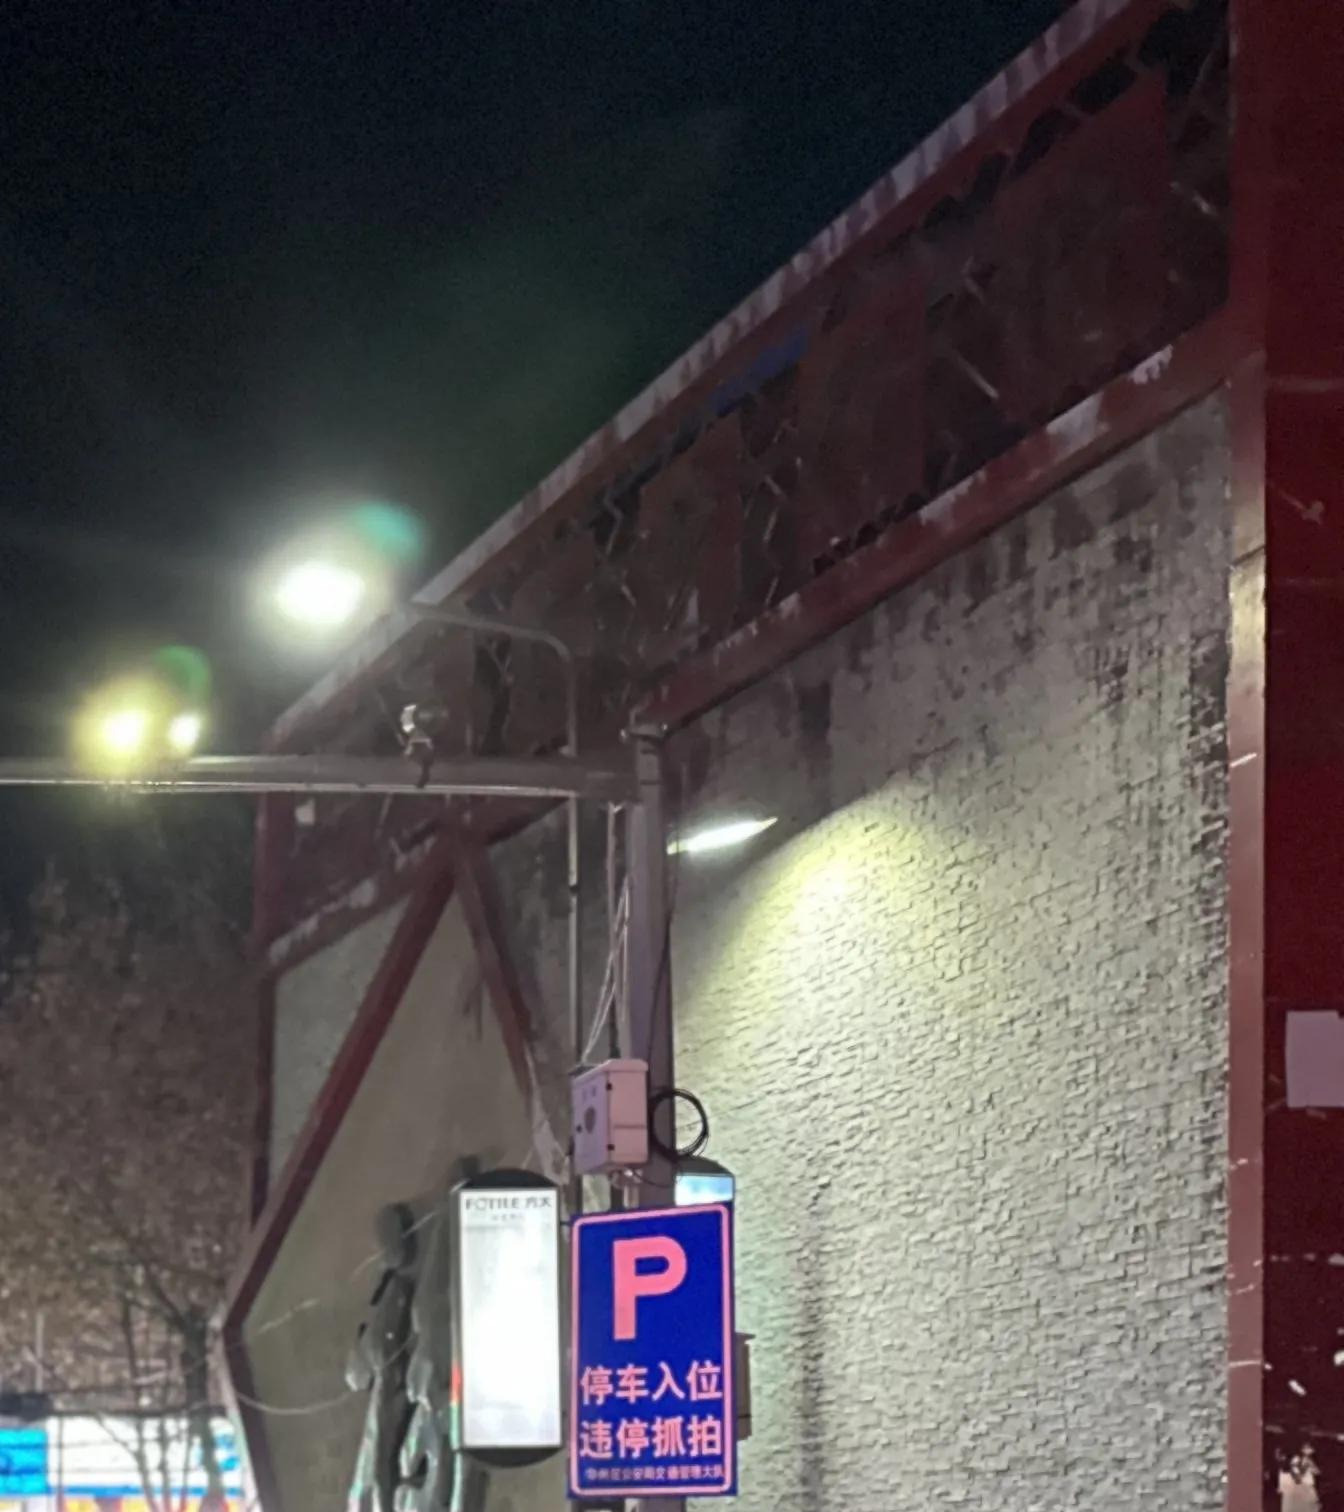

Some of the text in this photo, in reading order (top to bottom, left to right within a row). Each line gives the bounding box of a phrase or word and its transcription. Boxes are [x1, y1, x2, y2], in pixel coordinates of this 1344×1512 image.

[613, 1235, 687, 1340] P
[580, 1359, 723, 1405] 停车入位
[579, 1414, 722, 1458] 违停抓拍
